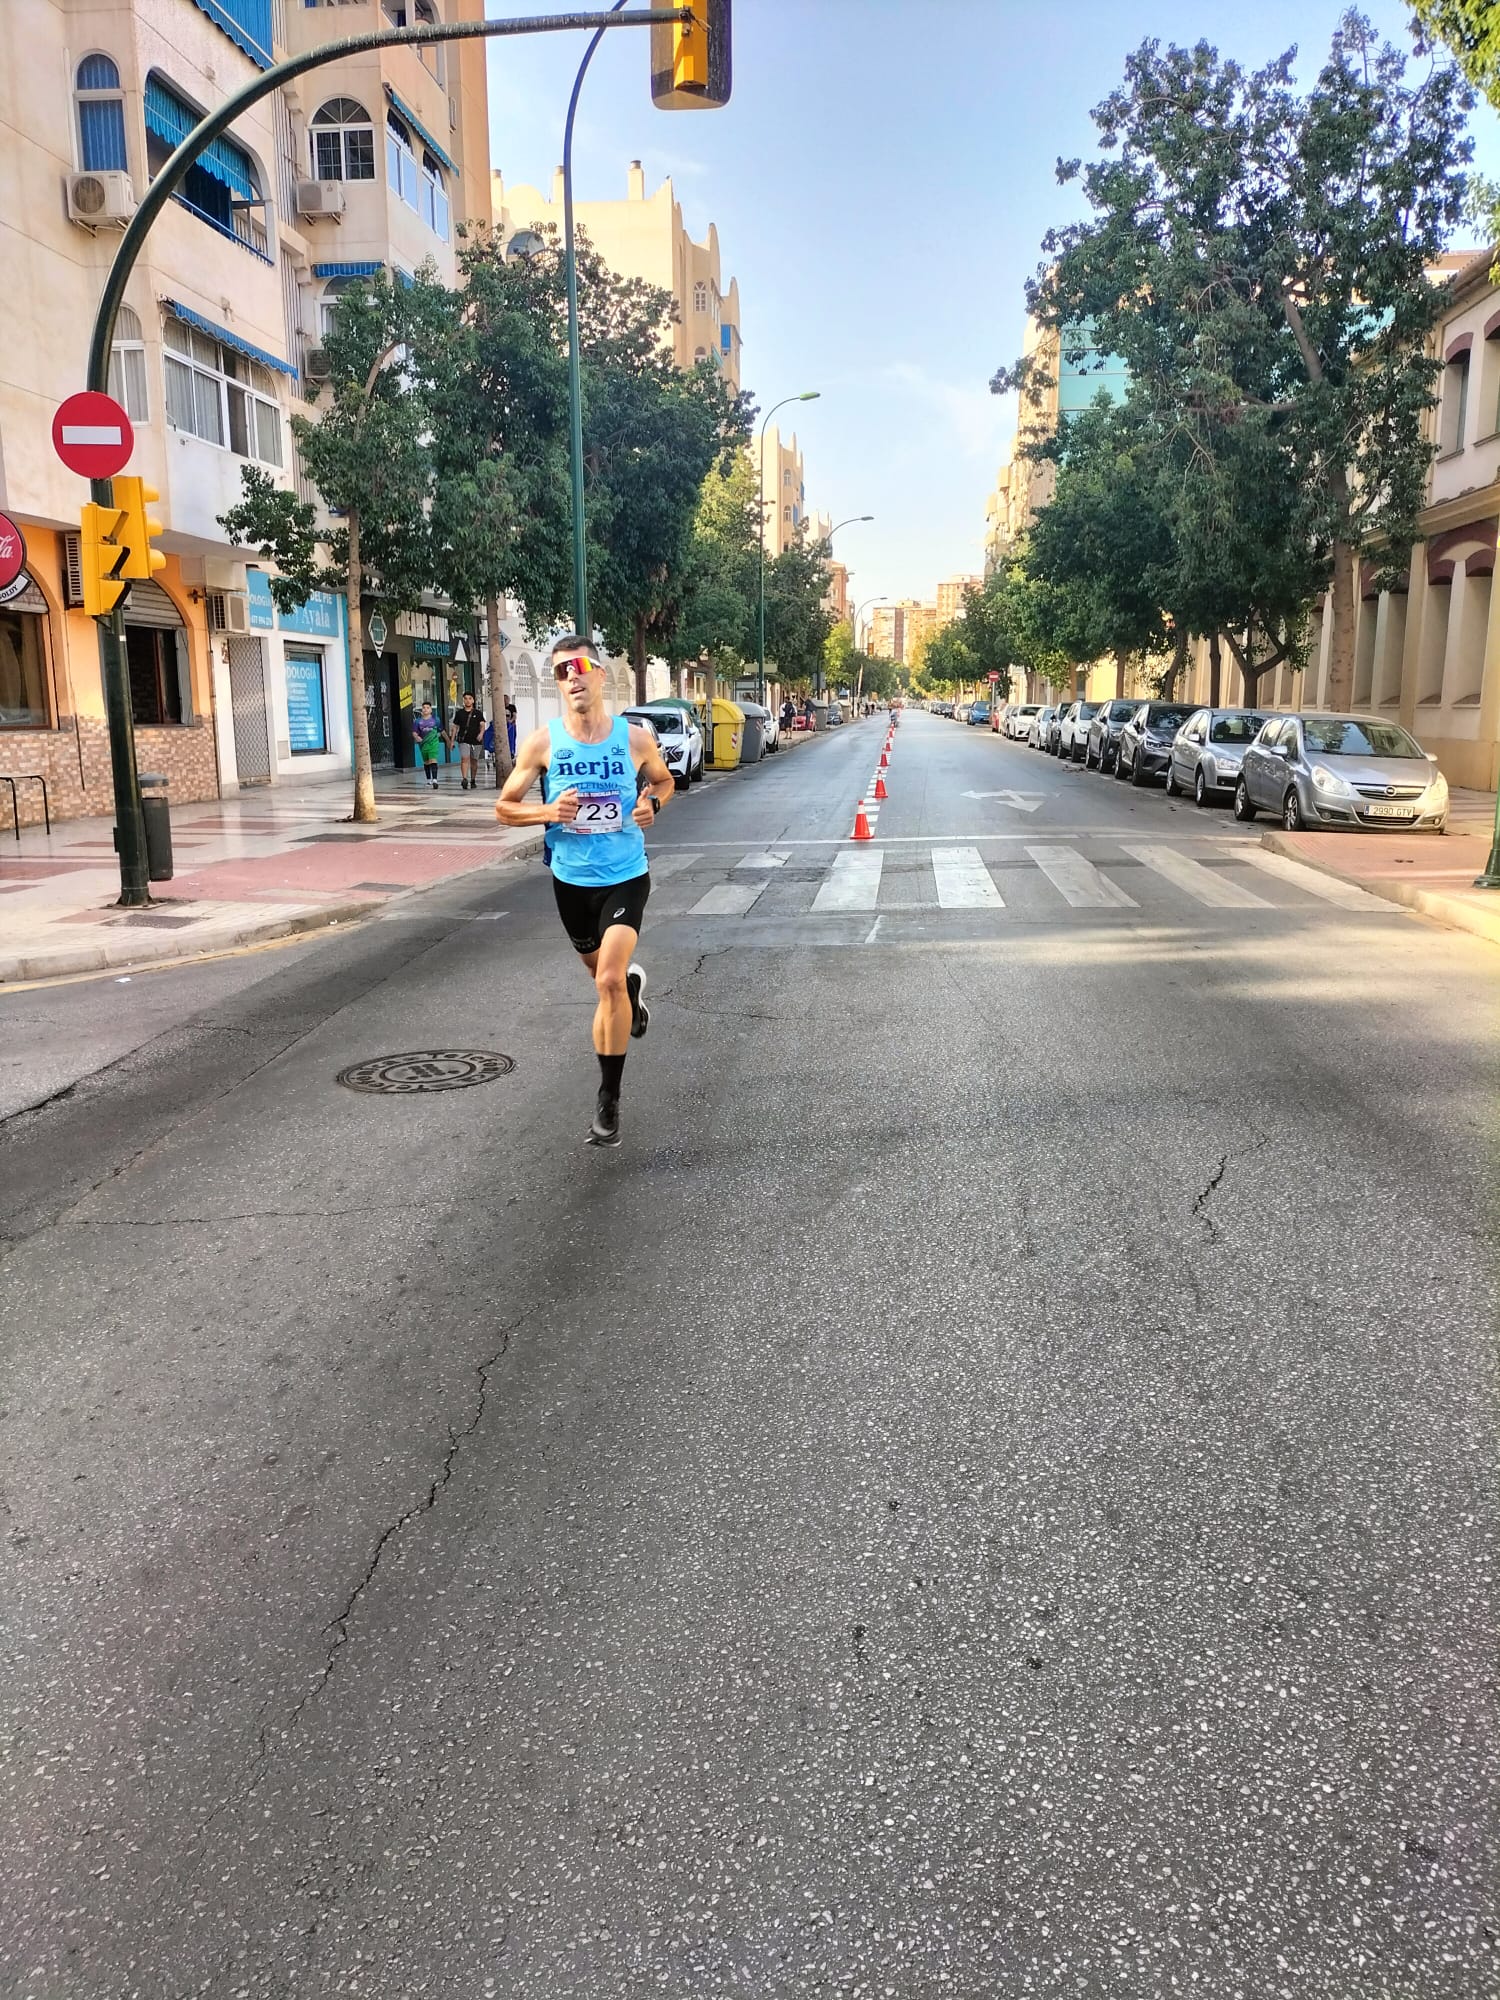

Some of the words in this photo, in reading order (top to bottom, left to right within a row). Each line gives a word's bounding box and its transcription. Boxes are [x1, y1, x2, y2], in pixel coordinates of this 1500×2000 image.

[303, 605, 329, 632] Ayala
[415, 639, 437, 655] FITNESS
[437, 643, 451, 656] CLUB
[557, 756, 625, 780] nerja
